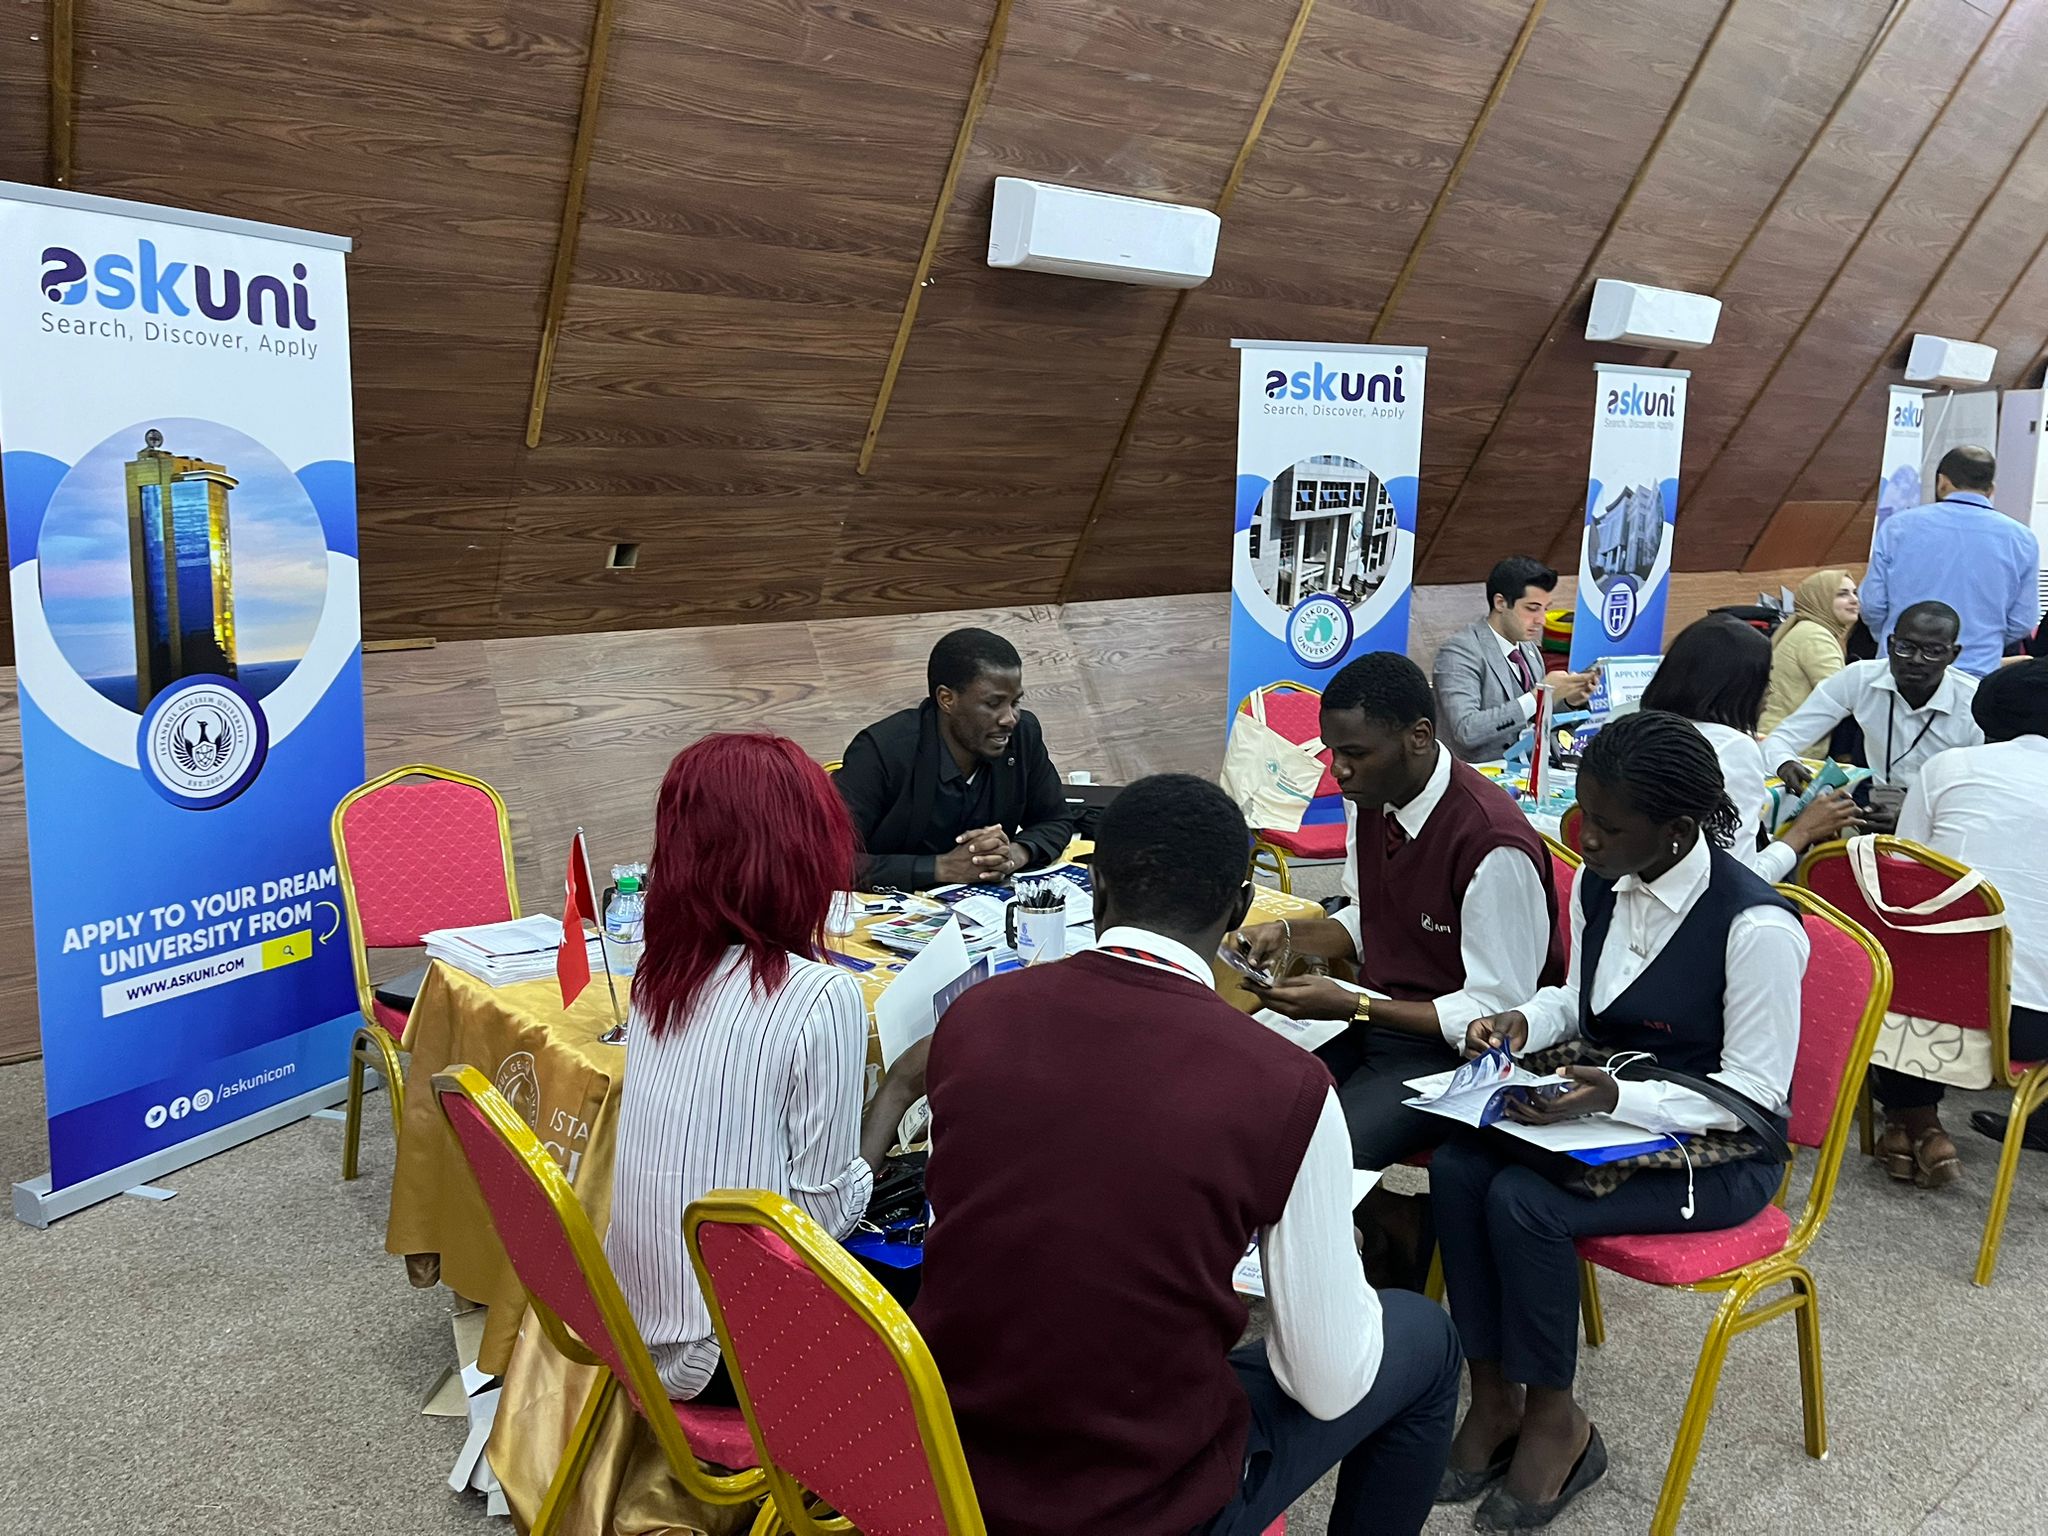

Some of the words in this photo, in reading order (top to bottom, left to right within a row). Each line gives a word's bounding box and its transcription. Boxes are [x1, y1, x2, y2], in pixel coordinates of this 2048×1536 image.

[41, 238, 316, 331] askuni
[41, 312, 133, 341] Search,
[145, 322, 248, 352] Discover,
[258, 335, 318, 360] Apply
[1265, 361, 1405, 403] askuni
[1607, 382, 1675, 417] askuni
[1264, 403, 1307, 416] Search,
[1313, 404, 1366, 418] Discover,
[1371, 407, 1405, 420] Apply
[1894, 400, 1923, 428] asku
[1297, 635, 1338, 655] UNIVERSITY
[1641, 670, 1656, 678] NO
[62, 912, 145, 954] APPLY
[150, 903, 186, 931] TO
[191, 886, 256, 921] YOUR
[262, 865, 337, 905] DREAM
[99, 919, 243, 977] UNIVERSITY
[249, 901, 312, 937] FROM
[126, 957, 245, 1001] WWW.ASKUNI.COM
[549, 1107, 589, 1141] ISTA
